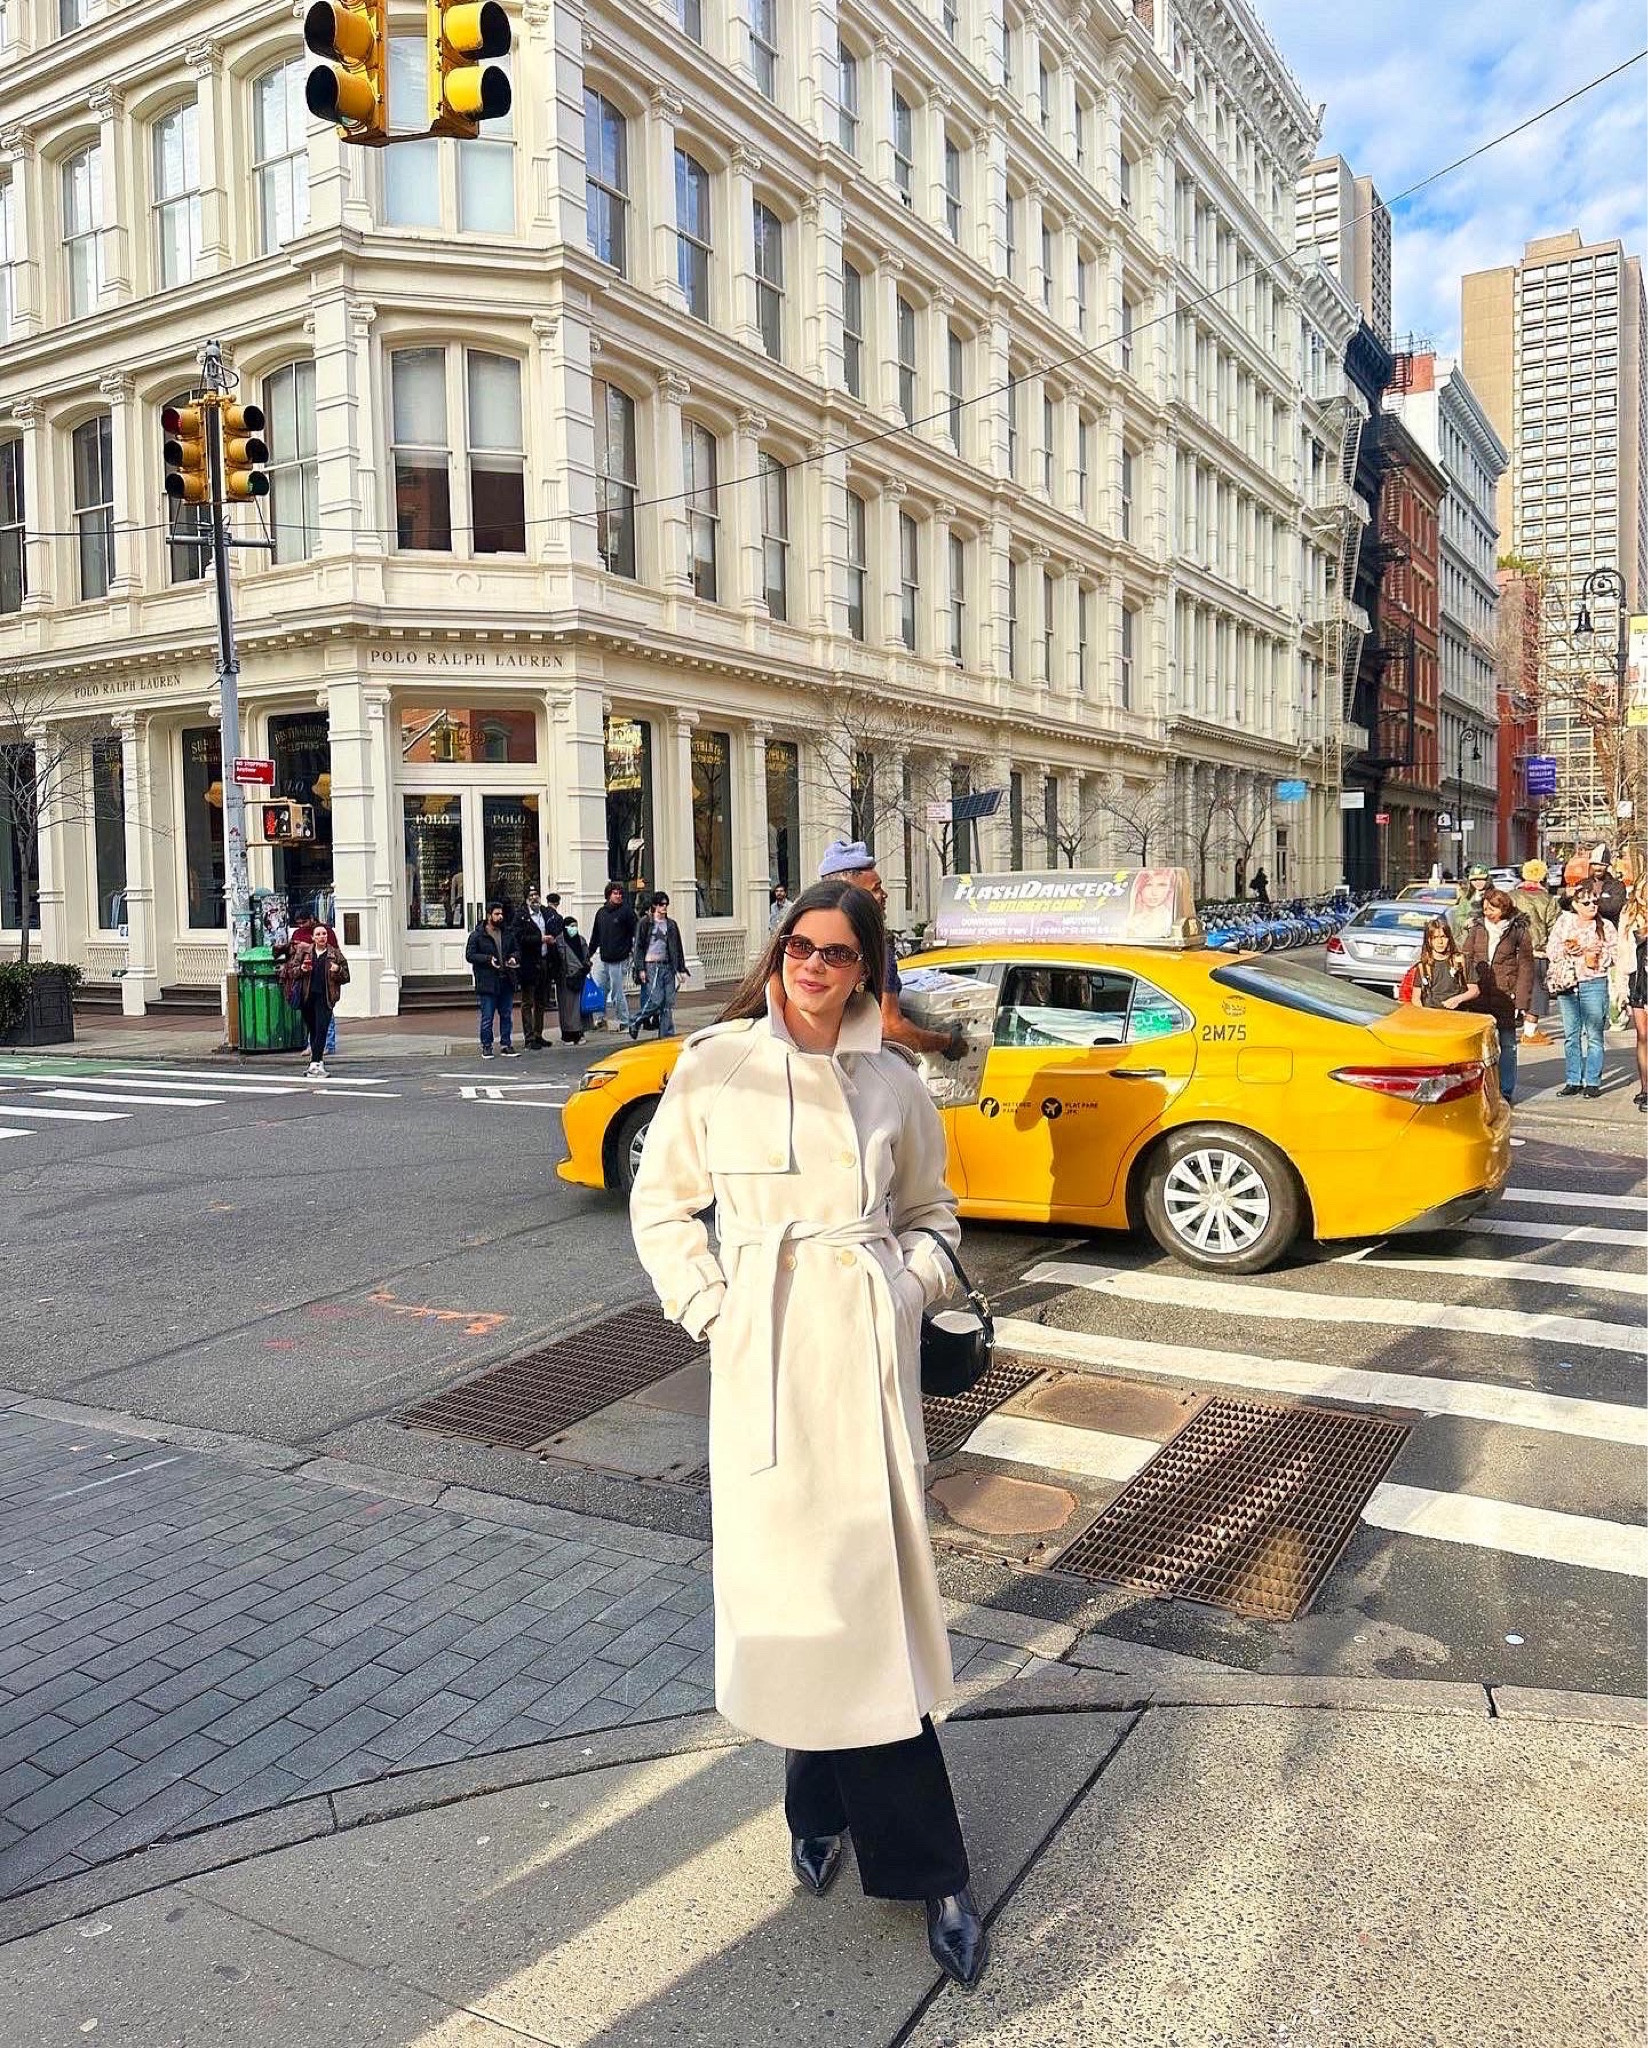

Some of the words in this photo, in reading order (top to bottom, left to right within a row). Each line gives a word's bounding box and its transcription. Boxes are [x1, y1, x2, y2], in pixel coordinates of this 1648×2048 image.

[370, 650, 418, 664] POLO
[427, 652, 486, 666] RALPH
[495, 654, 564, 668] LAUREN
[74, 686, 99, 699] POLO
[103, 680, 136, 695] RALPH
[140, 674, 181, 690] LAUREN
[415, 813, 450, 825] POLO
[493, 813, 526, 825] POLO
[1202, 1025, 1247, 1041] 2M75
